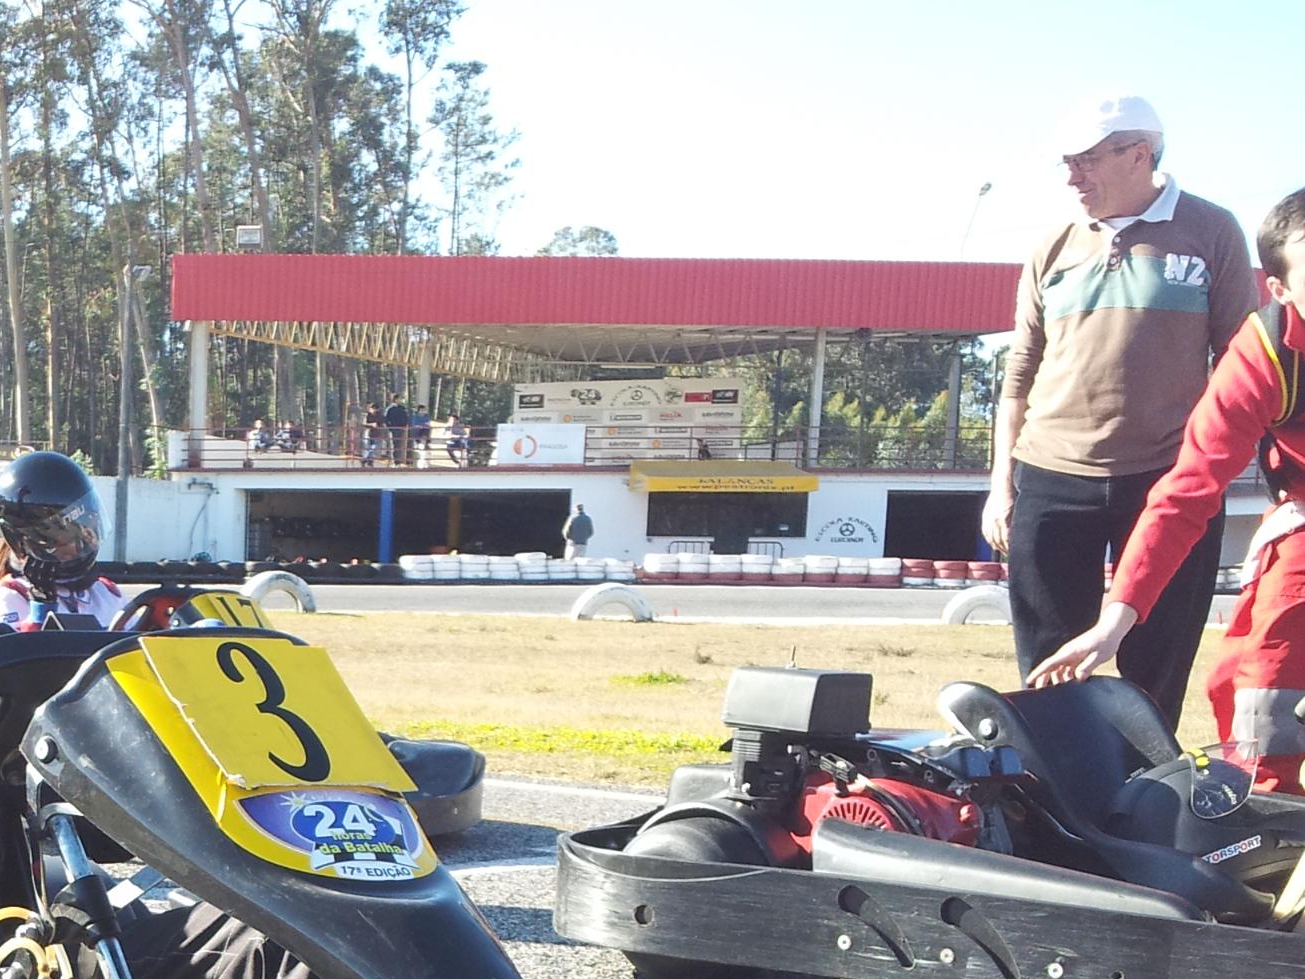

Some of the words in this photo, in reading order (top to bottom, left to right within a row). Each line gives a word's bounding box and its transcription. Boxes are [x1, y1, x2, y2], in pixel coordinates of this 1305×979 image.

[215, 596, 263, 628] 17
[216, 641, 331, 782] 3
[303, 804, 376, 837] 24
[319, 842, 341, 854] da
[344, 840, 404, 855] Batalha
[366, 864, 411, 879] EDIÇÃO
